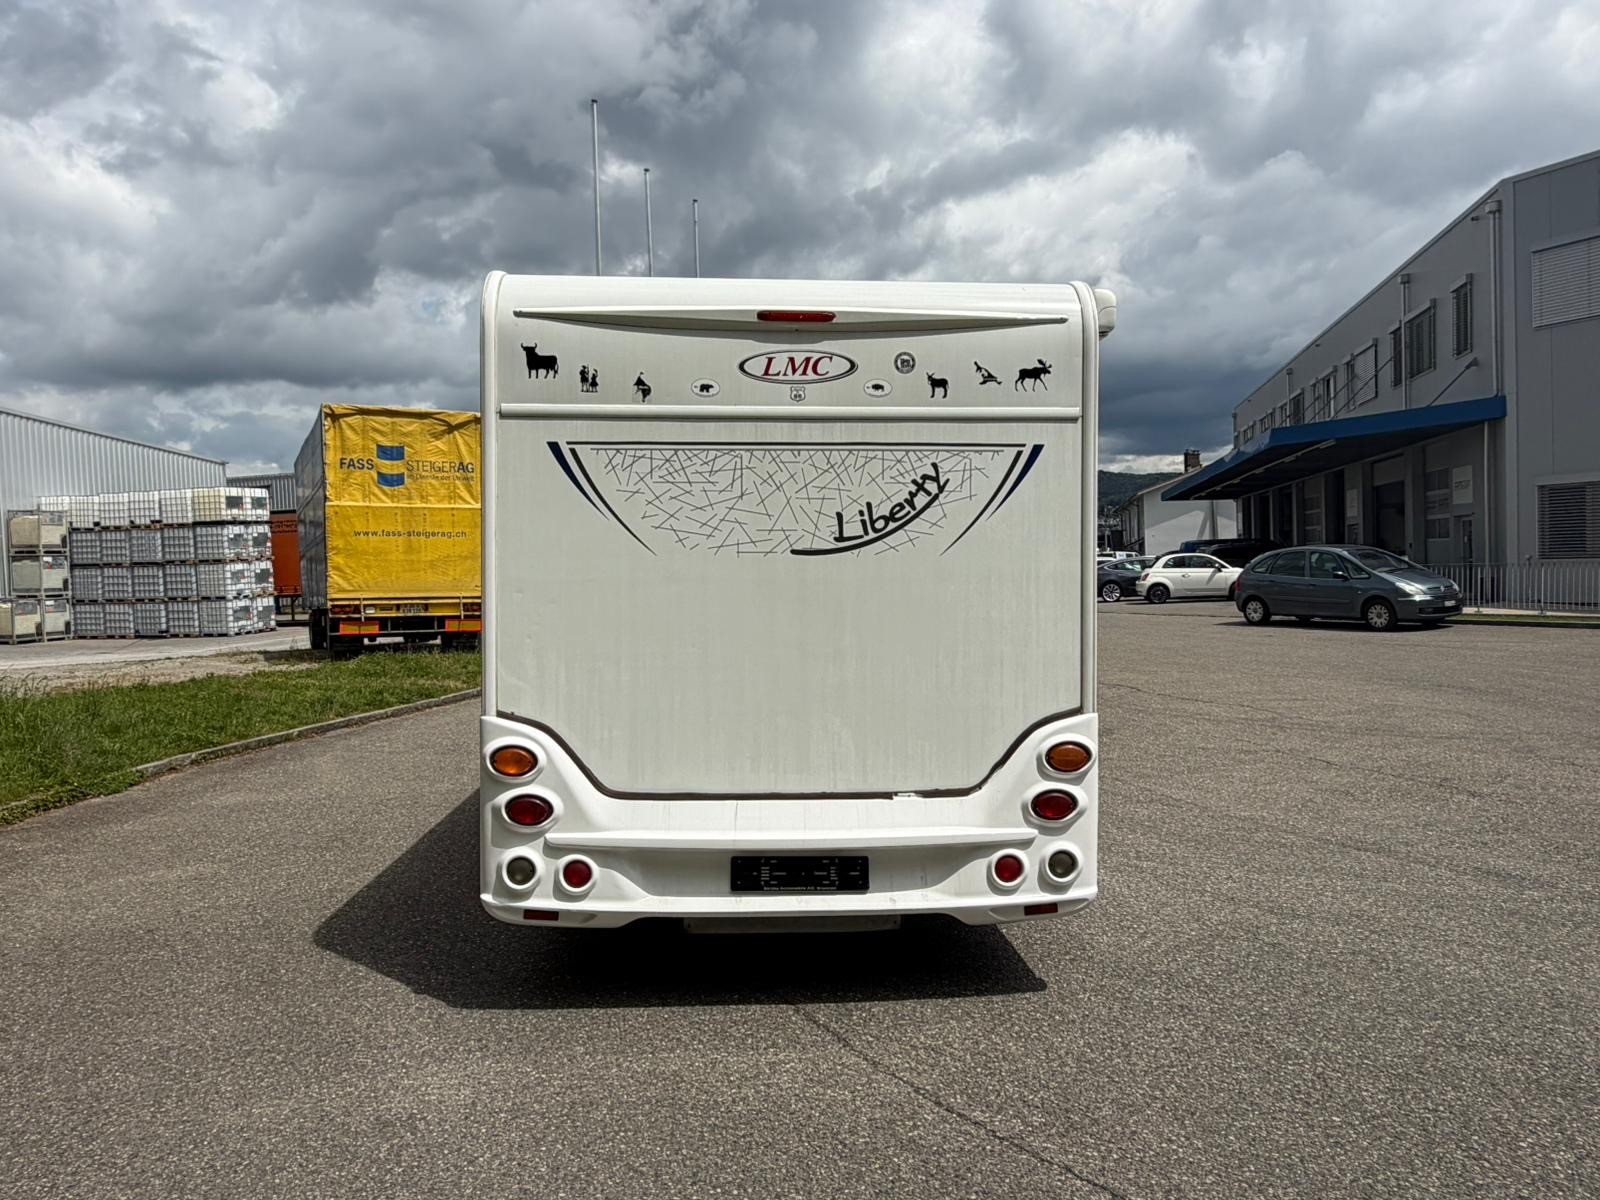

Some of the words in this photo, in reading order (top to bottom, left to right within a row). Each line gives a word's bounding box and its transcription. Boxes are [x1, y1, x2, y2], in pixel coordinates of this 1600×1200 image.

[761, 355, 833, 377] LMC
[339, 457, 375, 470] FASS
[406, 460, 475, 474] STEIGERAG
[833, 461, 950, 543] Liberty
[353, 529, 467, 539] www.fass-steigerag.ch
